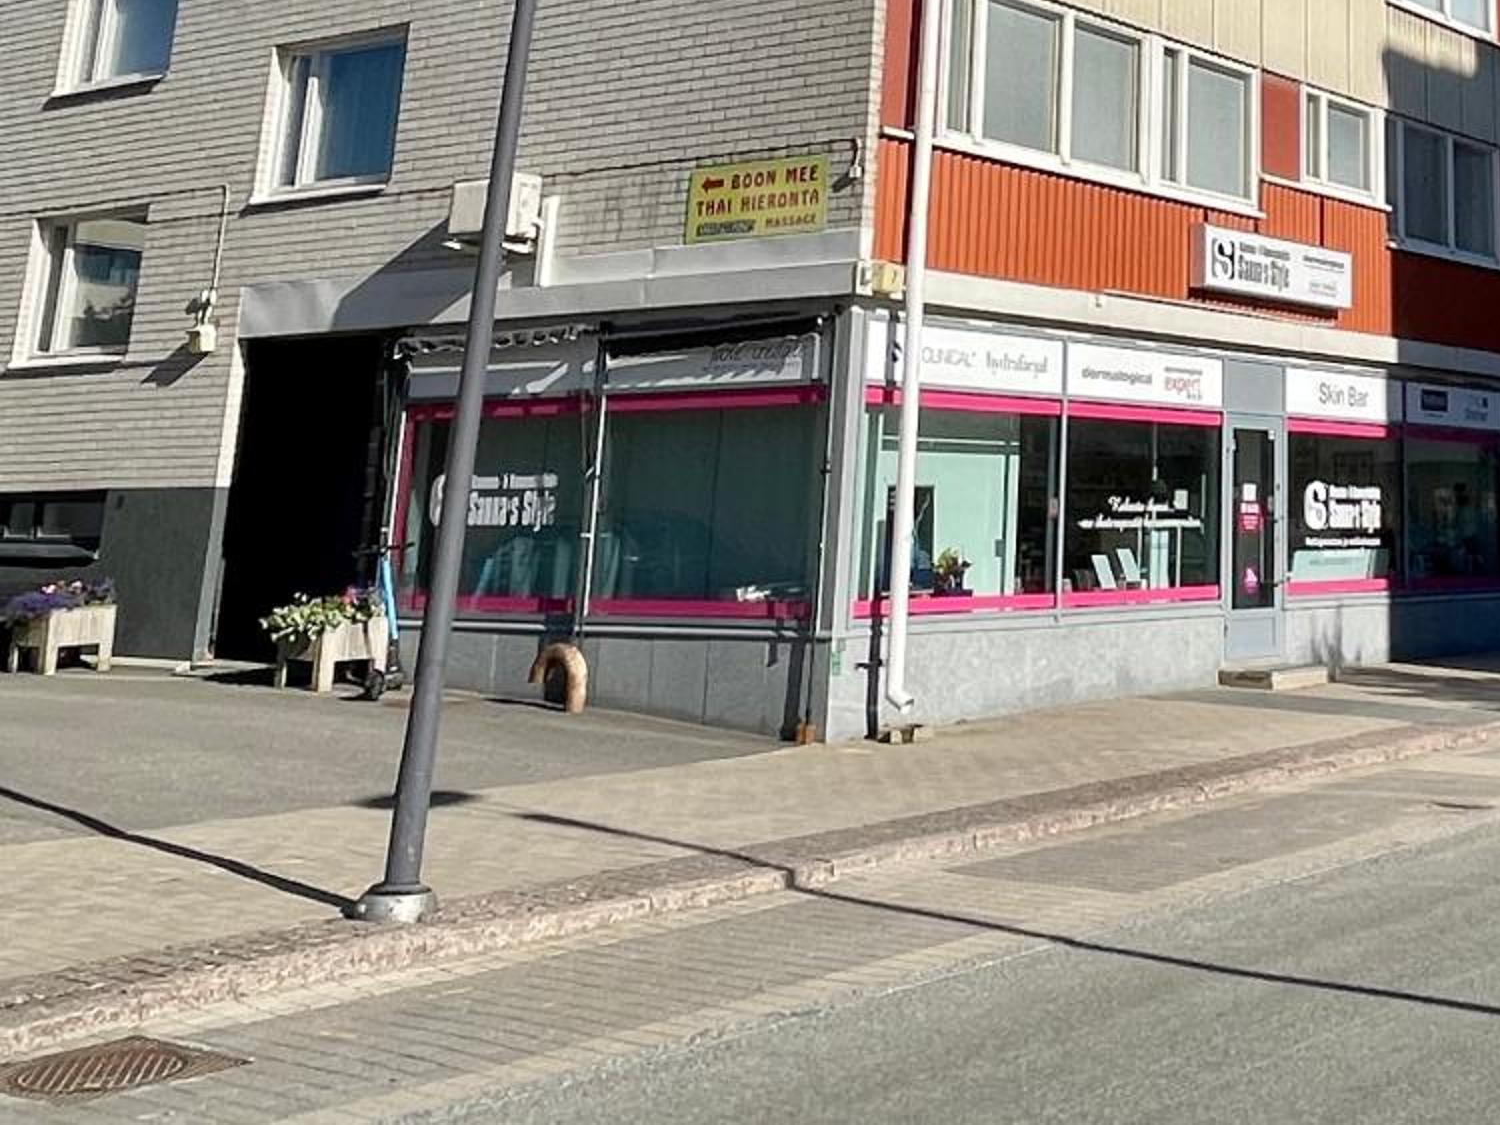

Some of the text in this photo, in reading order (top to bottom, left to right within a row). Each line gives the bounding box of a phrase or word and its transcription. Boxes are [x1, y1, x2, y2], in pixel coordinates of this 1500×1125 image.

[731, 164, 819, 190] BOON MEE
[696, 188, 820, 217] THAI HIERONTA
[765, 213, 817, 228] MASSAGE
[1319, 382, 1368, 407] Skin Bar
